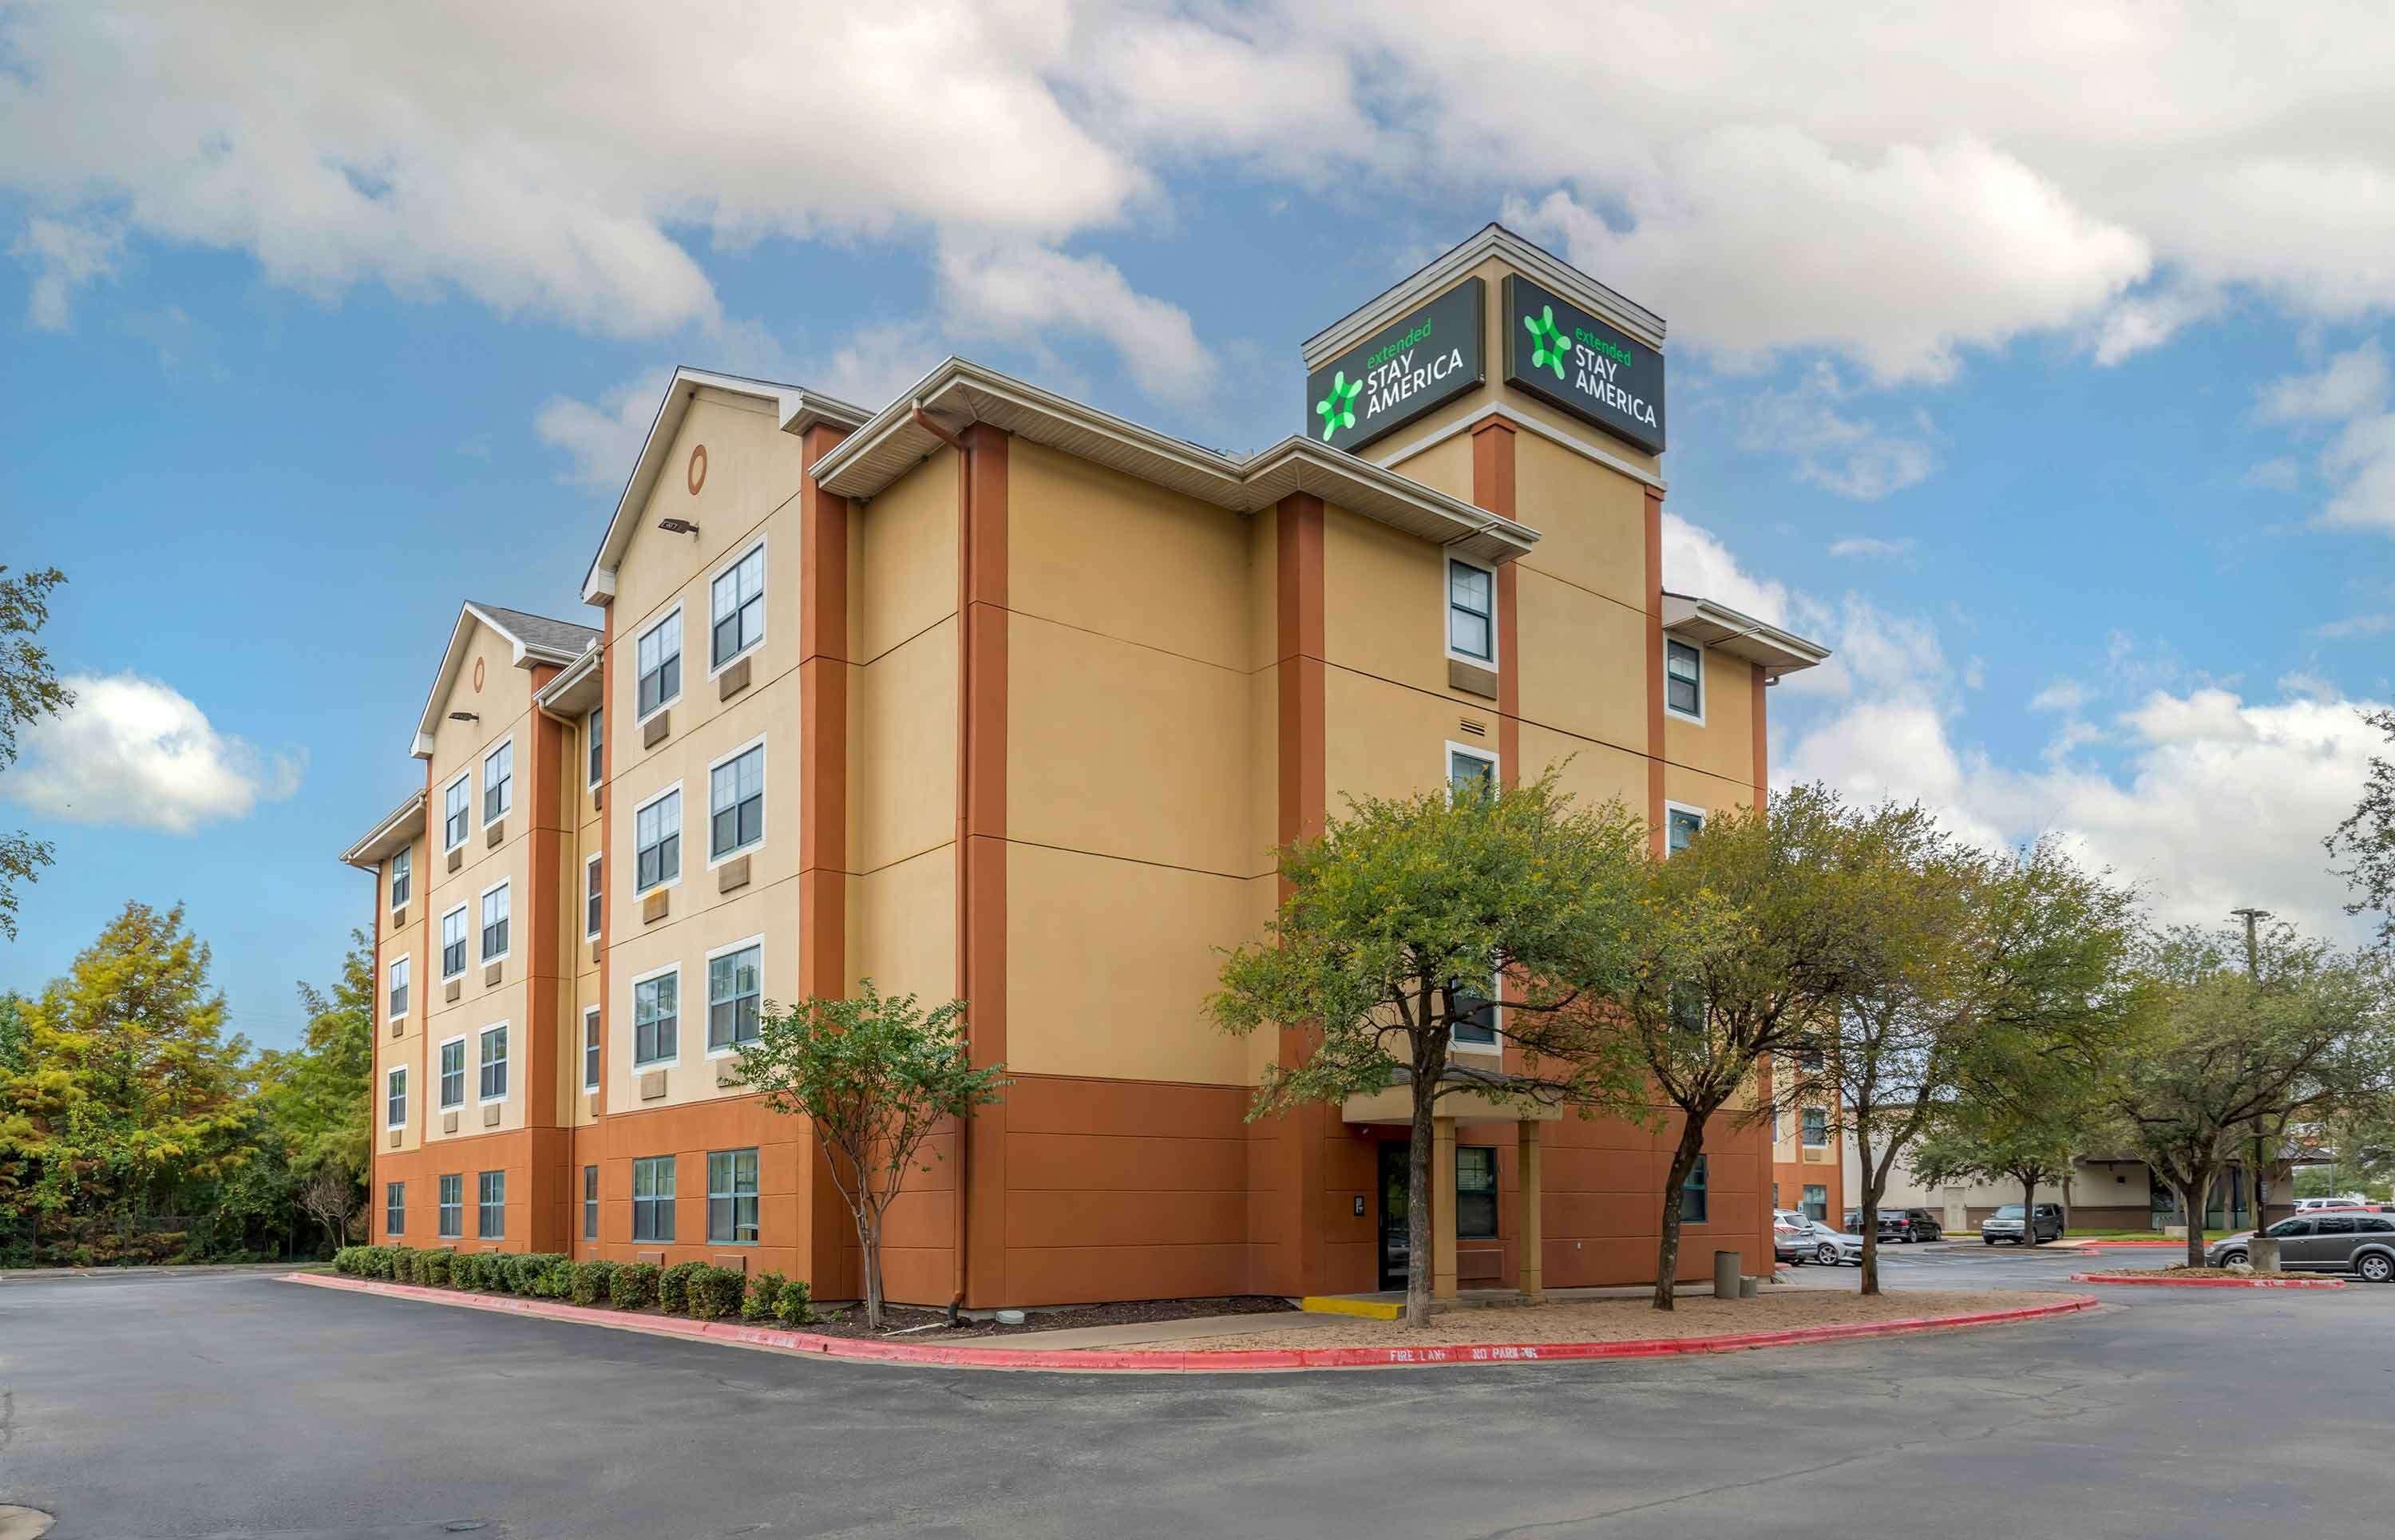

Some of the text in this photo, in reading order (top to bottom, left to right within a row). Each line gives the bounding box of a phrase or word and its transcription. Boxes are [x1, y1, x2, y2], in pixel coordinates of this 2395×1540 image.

[1368, 318, 1431, 369] extended
[1575, 327, 1631, 366] extended
[1575, 344, 1617, 382] STAY
[1366, 348, 1463, 419] AMERICA
[1368, 349, 1414, 394] STAY
[1575, 369, 1657, 428] AMERICA
[1391, 1349, 1415, 1361] FIRE
[1472, 1348, 1487, 1360] NO
